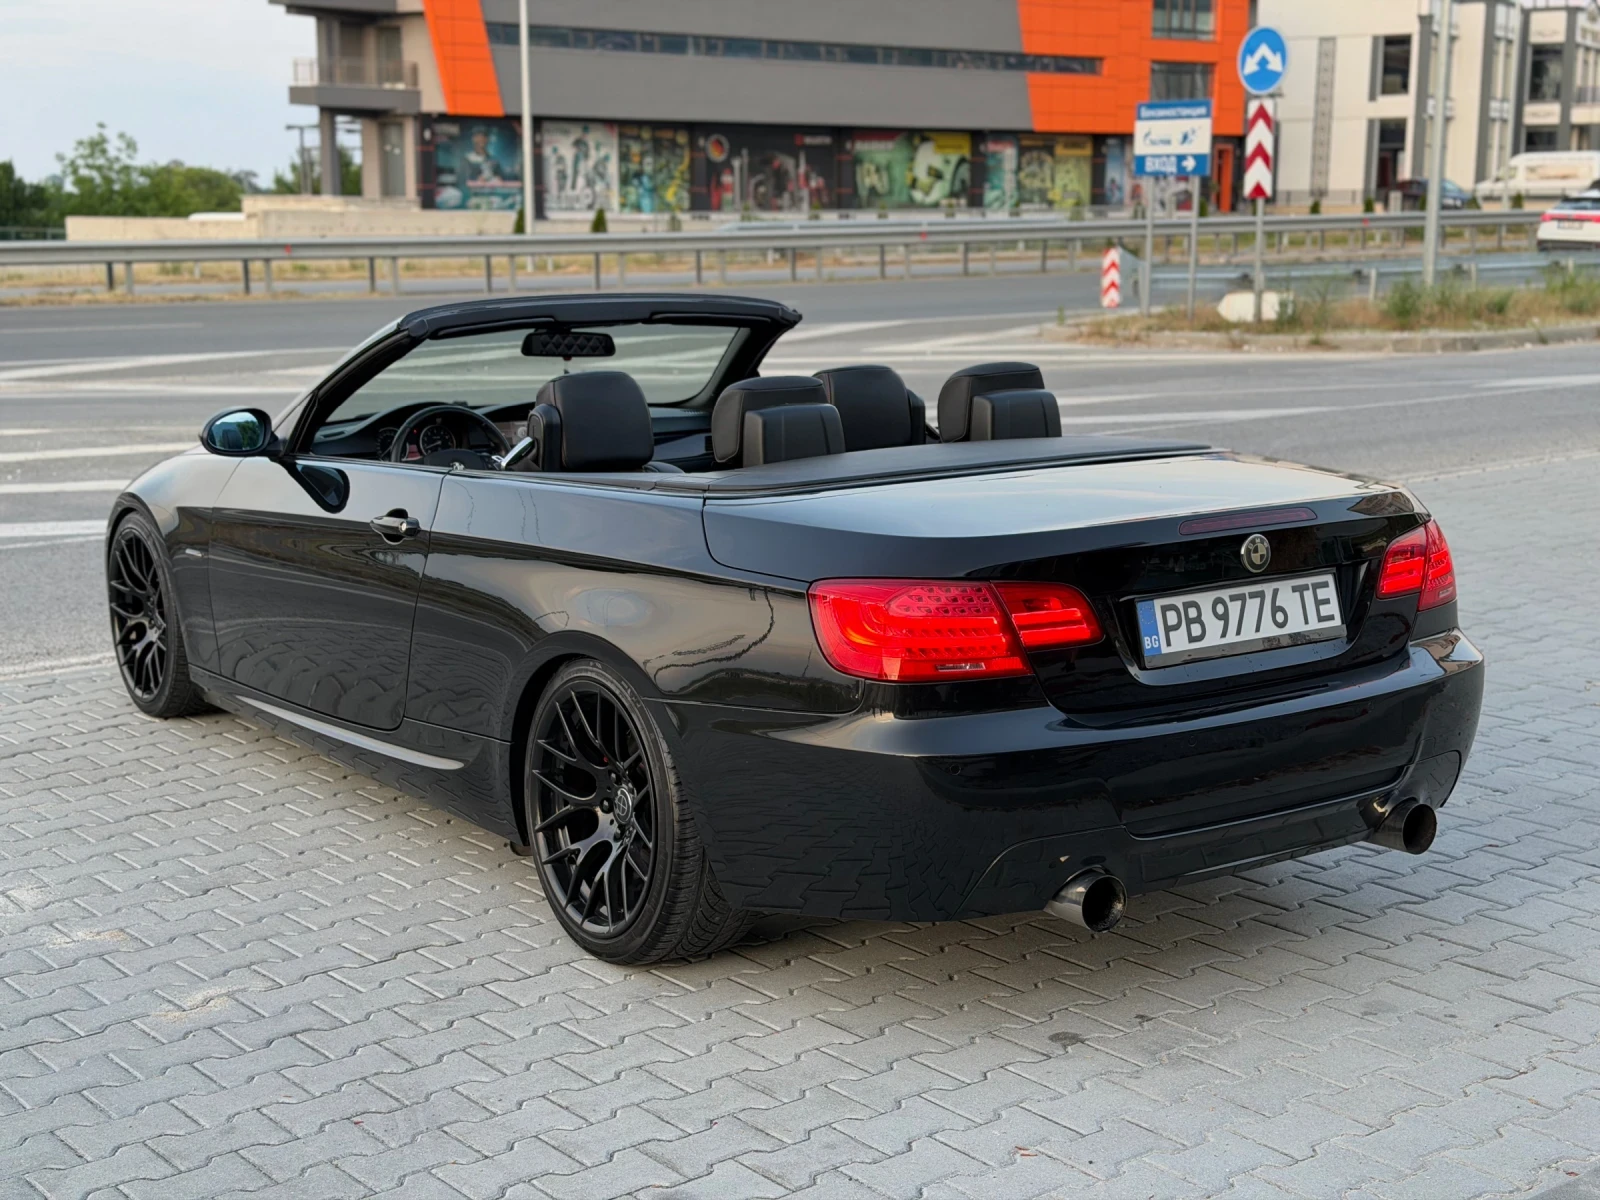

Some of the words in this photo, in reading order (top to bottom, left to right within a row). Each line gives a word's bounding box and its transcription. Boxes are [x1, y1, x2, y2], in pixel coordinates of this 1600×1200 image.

[1160, 600, 1207, 647] PB
[1211, 587, 1289, 639] 9776
[1291, 580, 1335, 625] TE
[1144, 635, 1159, 649] BG
